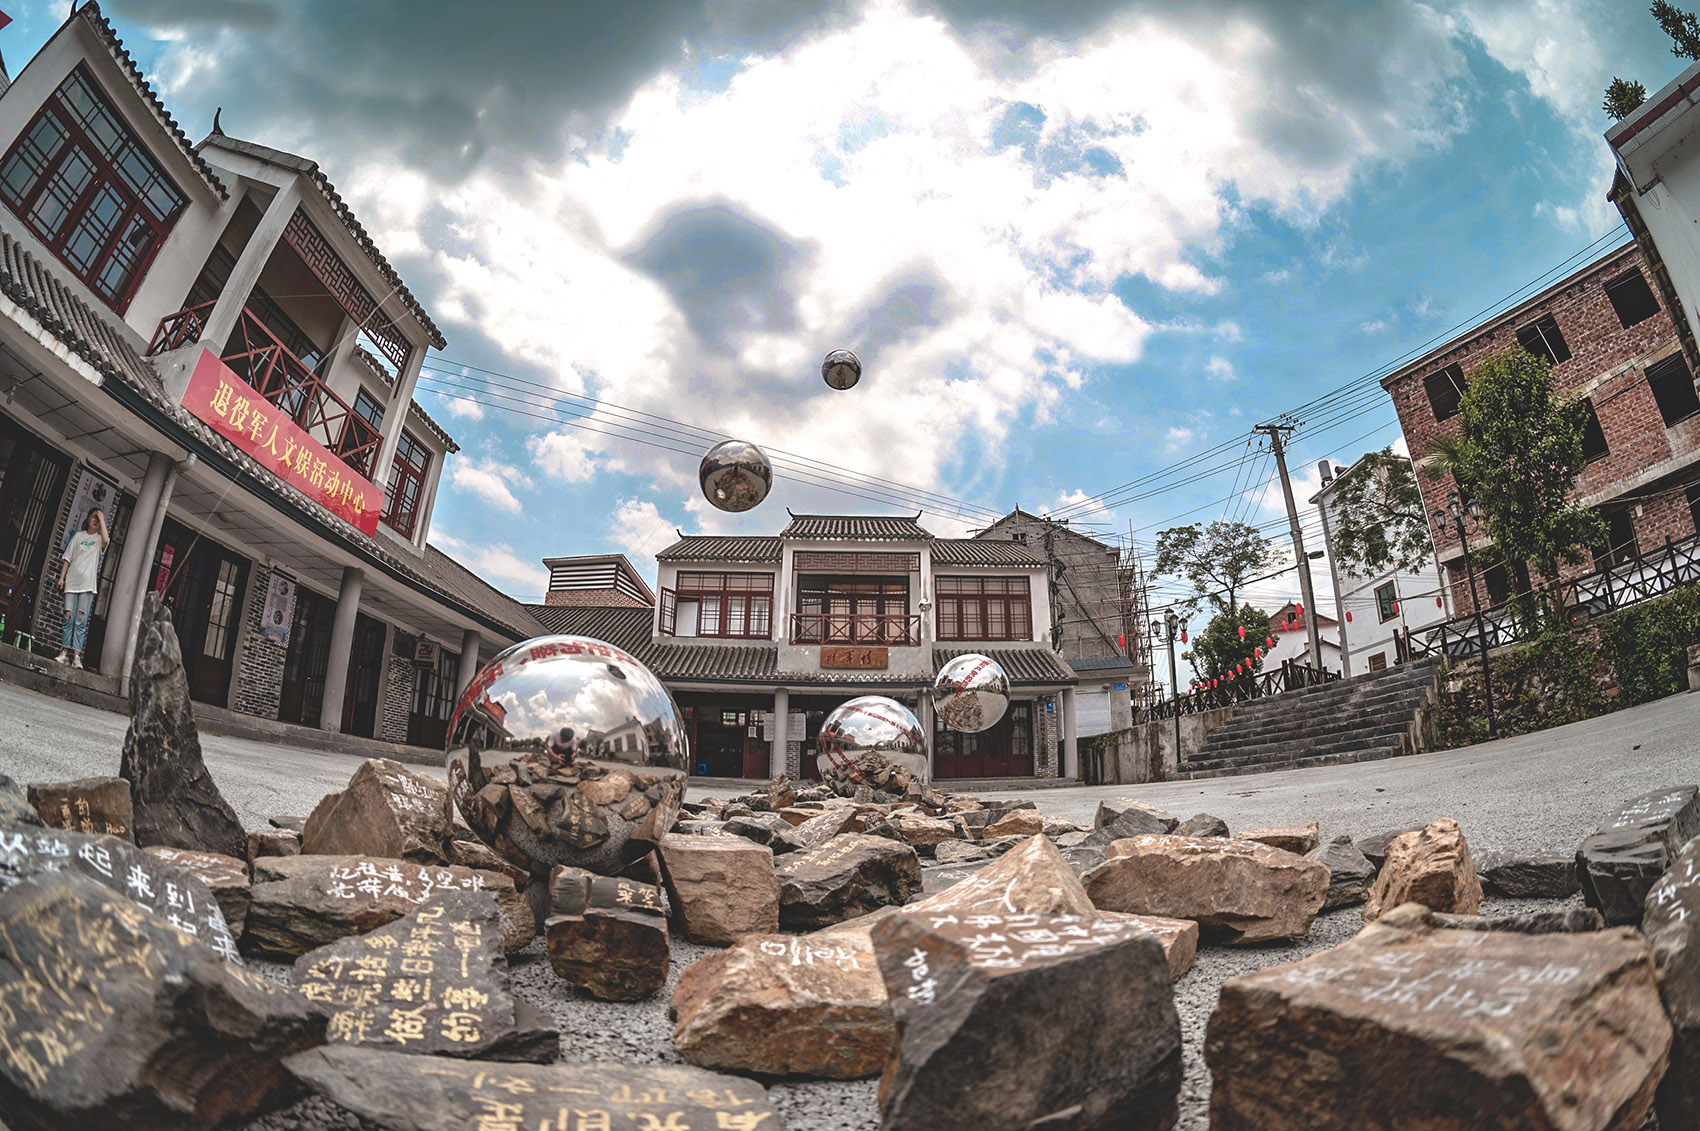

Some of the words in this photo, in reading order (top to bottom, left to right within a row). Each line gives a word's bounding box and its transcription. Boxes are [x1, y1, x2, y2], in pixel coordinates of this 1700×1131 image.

[209, 380, 366, 515] 退役军人文娱活动中心
